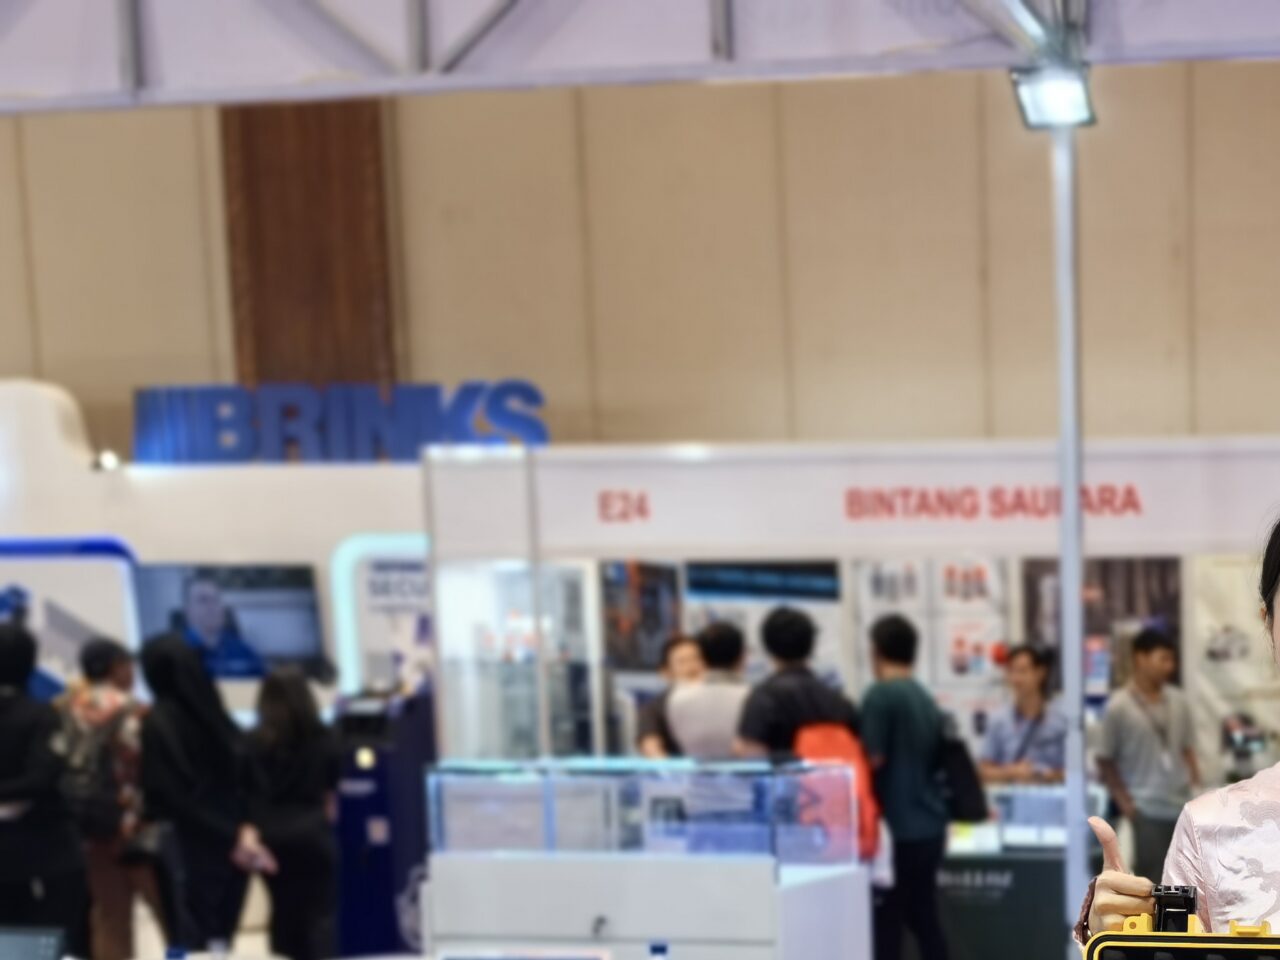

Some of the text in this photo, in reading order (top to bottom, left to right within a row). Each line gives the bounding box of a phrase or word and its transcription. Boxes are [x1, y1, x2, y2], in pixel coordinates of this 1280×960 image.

[598, 489, 650, 522] E24
[844, 484, 1143, 521] BINTANG SAUARA
